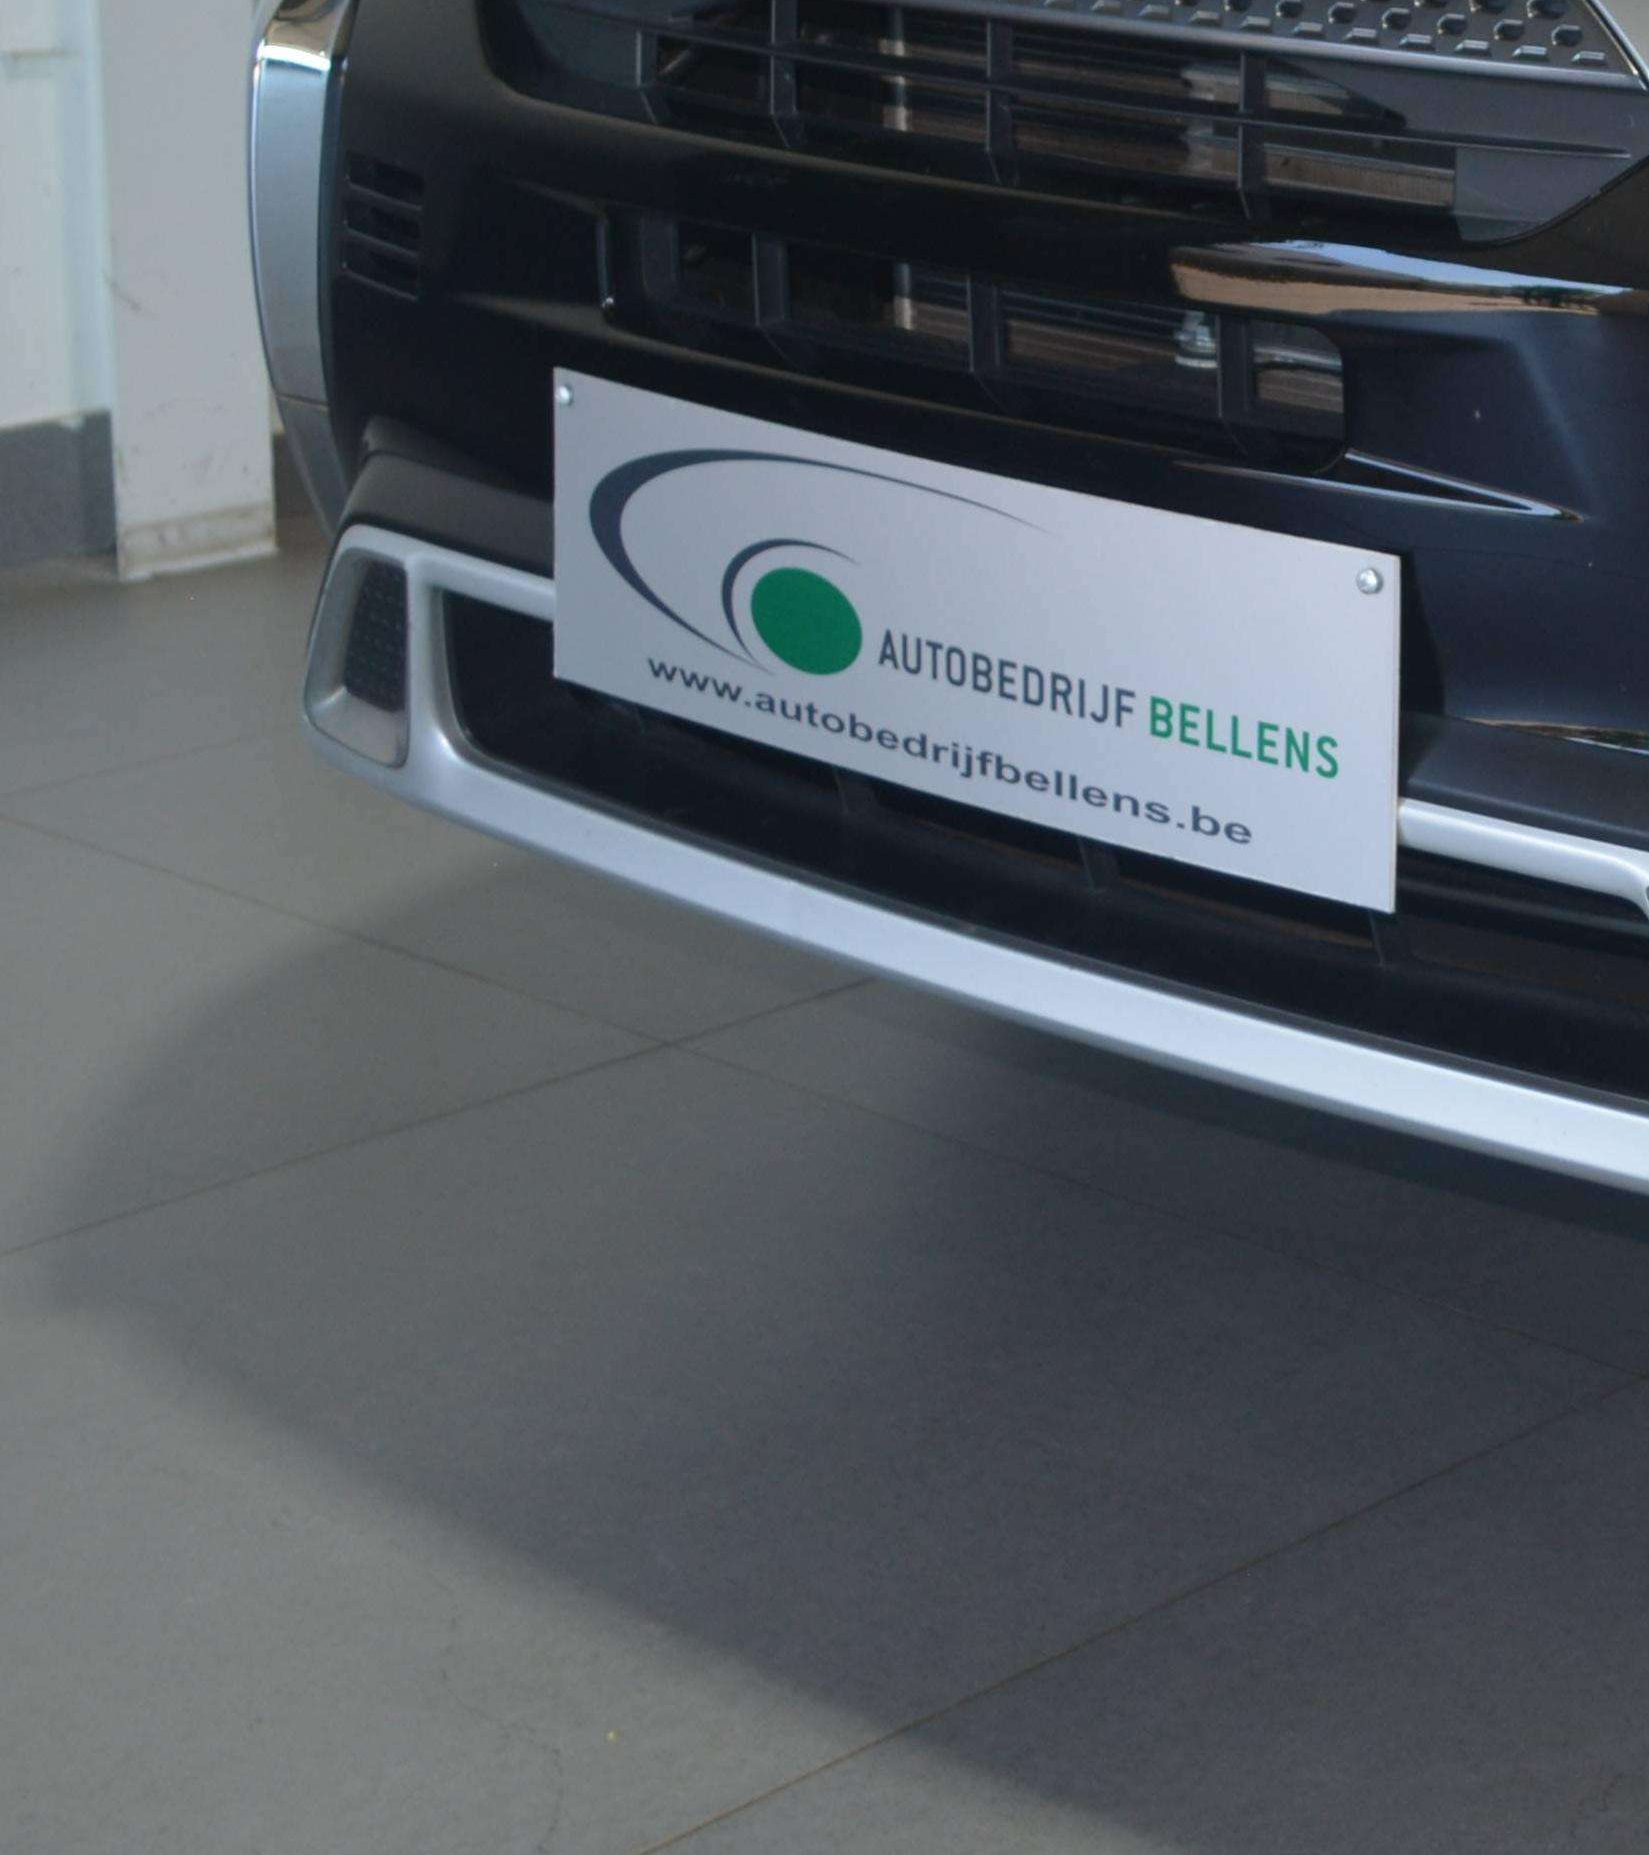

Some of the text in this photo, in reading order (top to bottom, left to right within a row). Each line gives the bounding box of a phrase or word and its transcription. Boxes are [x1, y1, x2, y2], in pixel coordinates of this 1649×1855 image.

[645, 656, 1253, 846] www.autobedrijfbellens.be
[876, 627, 1340, 780] AUTOBEDRIJF BELLENS
